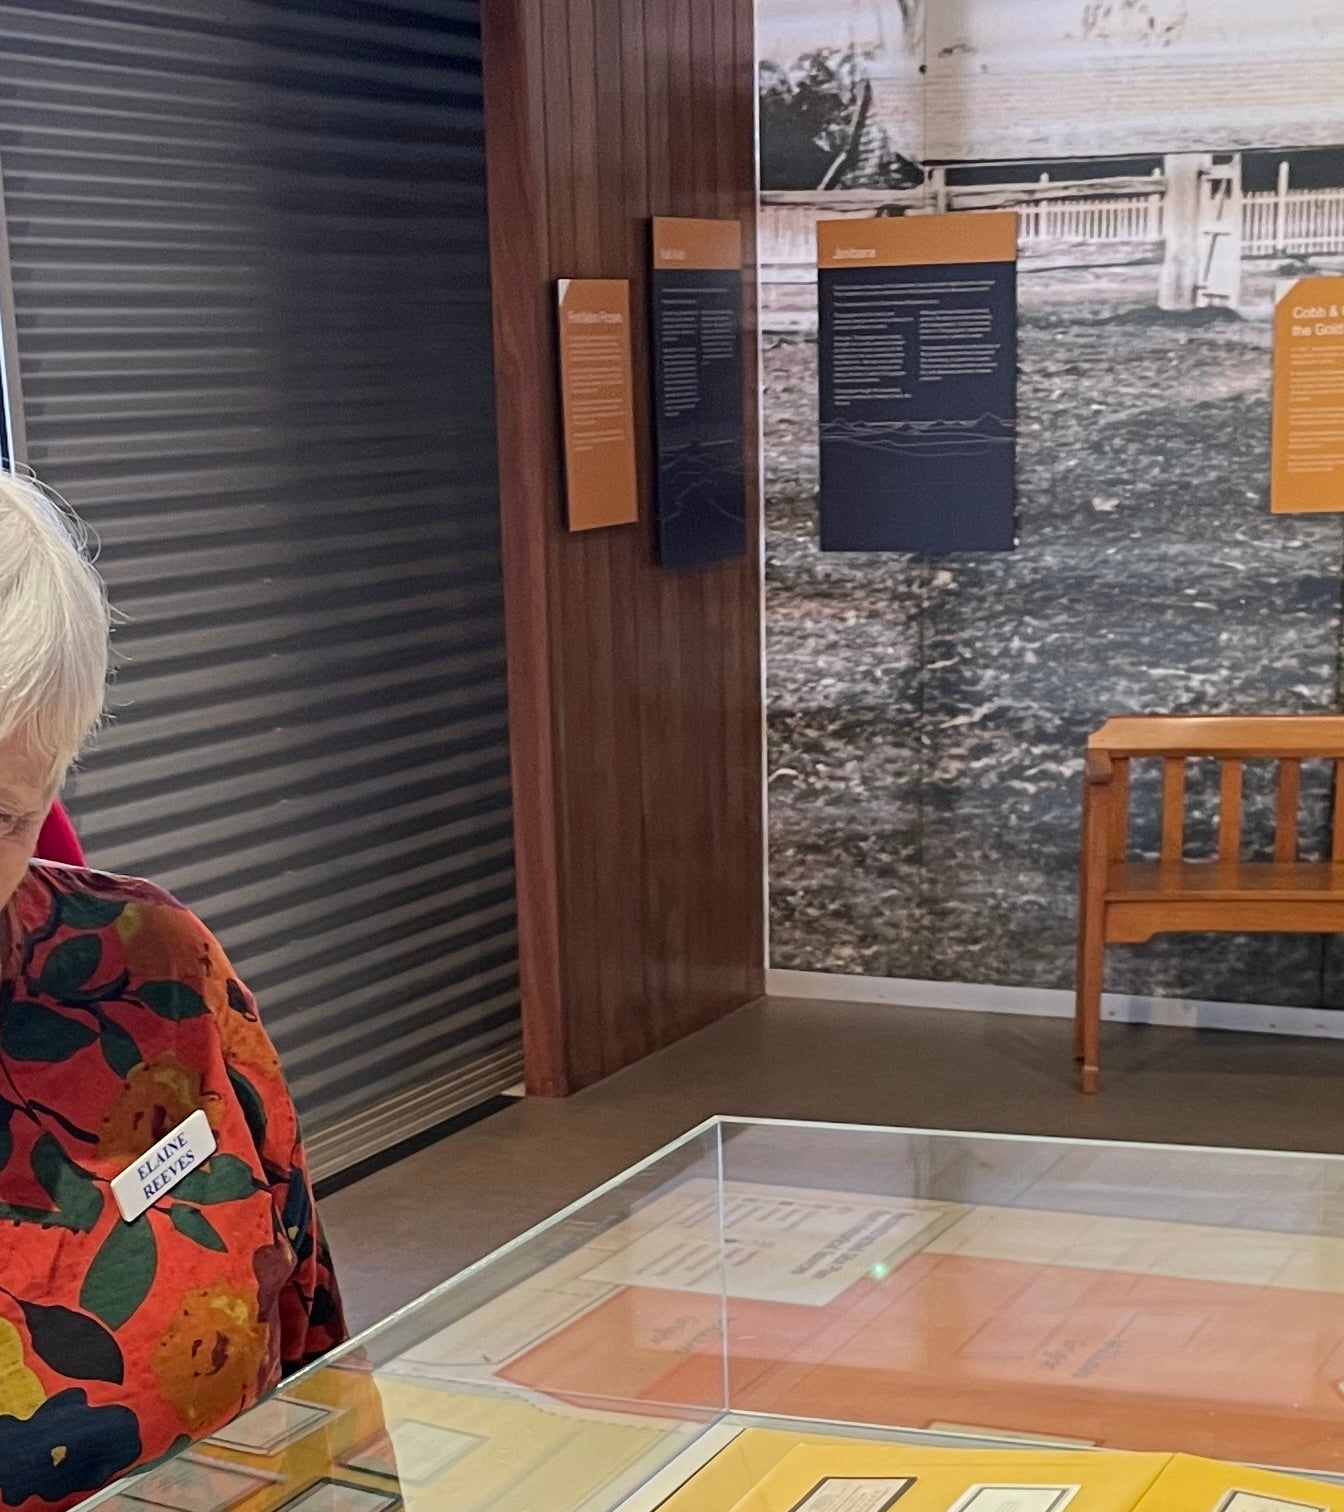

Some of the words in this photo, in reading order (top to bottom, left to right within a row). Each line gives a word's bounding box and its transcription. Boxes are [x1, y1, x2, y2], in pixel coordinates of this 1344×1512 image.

[1292, 306, 1326, 319] Cobb
[1329, 305, 1338, 317] &
[1292, 326, 1312, 336] the
[1315, 324, 1344, 336] Gold
[136, 1132, 188, 1181] ELAINE
[142, 1149, 195, 1200] REEVES
